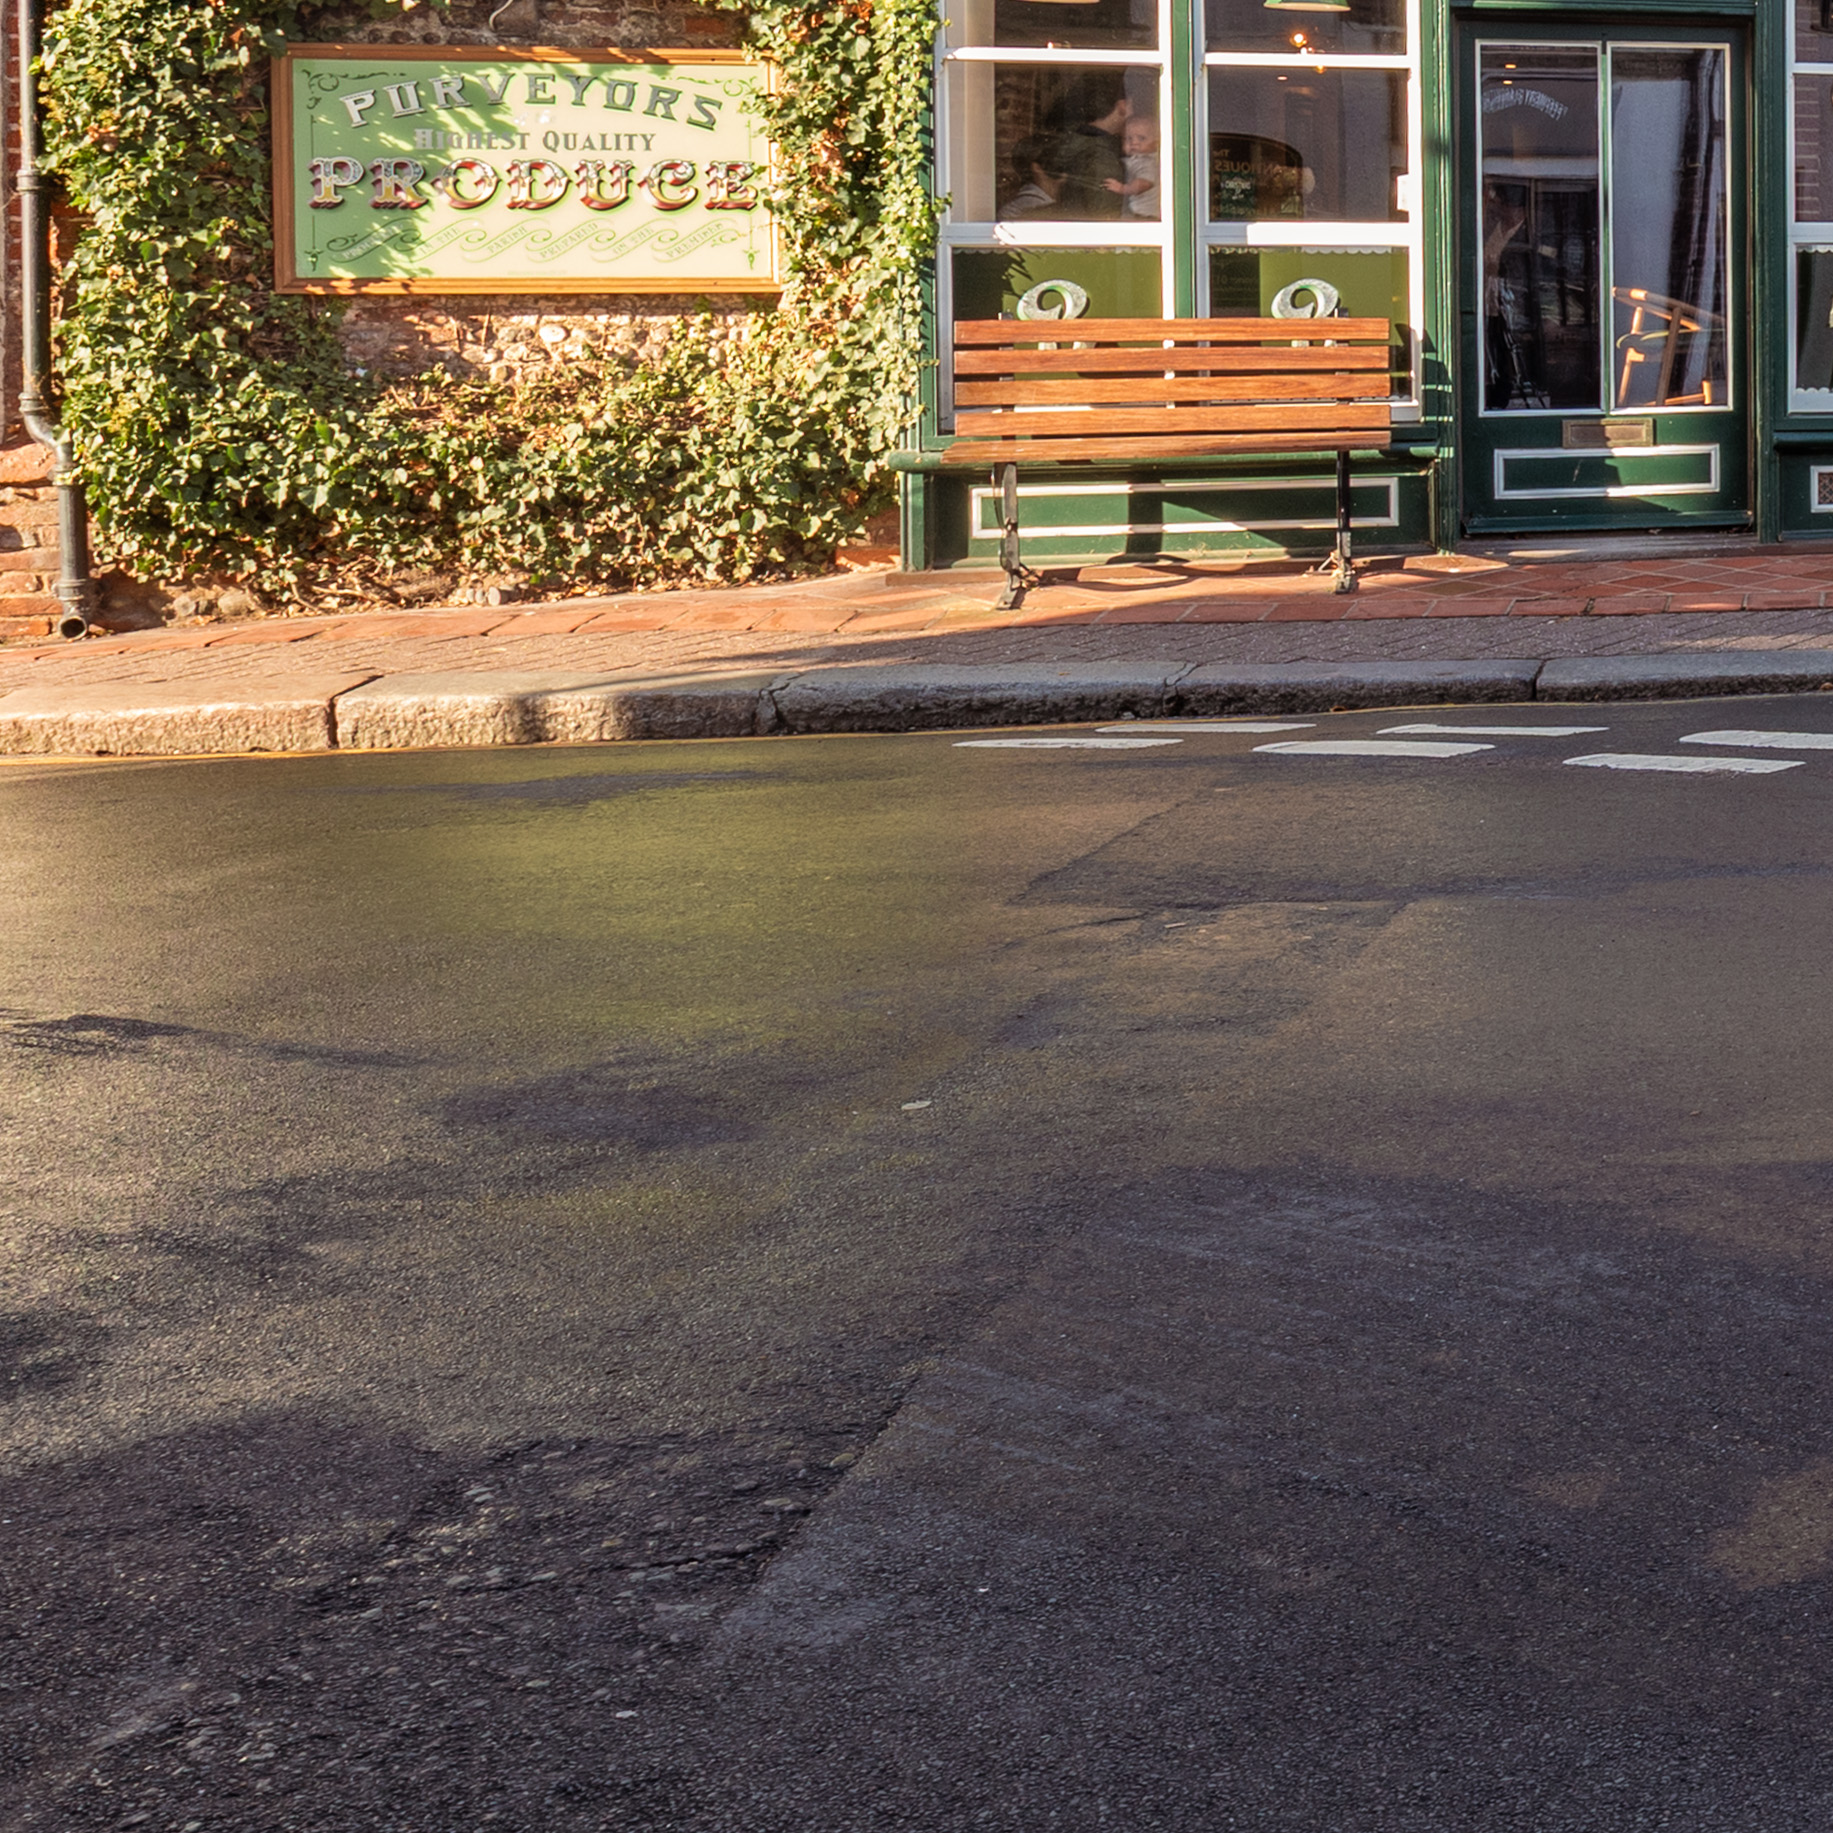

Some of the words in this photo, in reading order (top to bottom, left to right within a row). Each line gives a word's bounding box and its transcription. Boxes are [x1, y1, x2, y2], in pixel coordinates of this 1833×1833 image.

[338, 72, 724, 132] PURVEYORS
[414, 127, 530, 152] HIGHEST
[542, 129, 657, 154] QUALITY
[308, 156, 760, 211] PRODUCE
[539, 221, 599, 259] PREPARED
